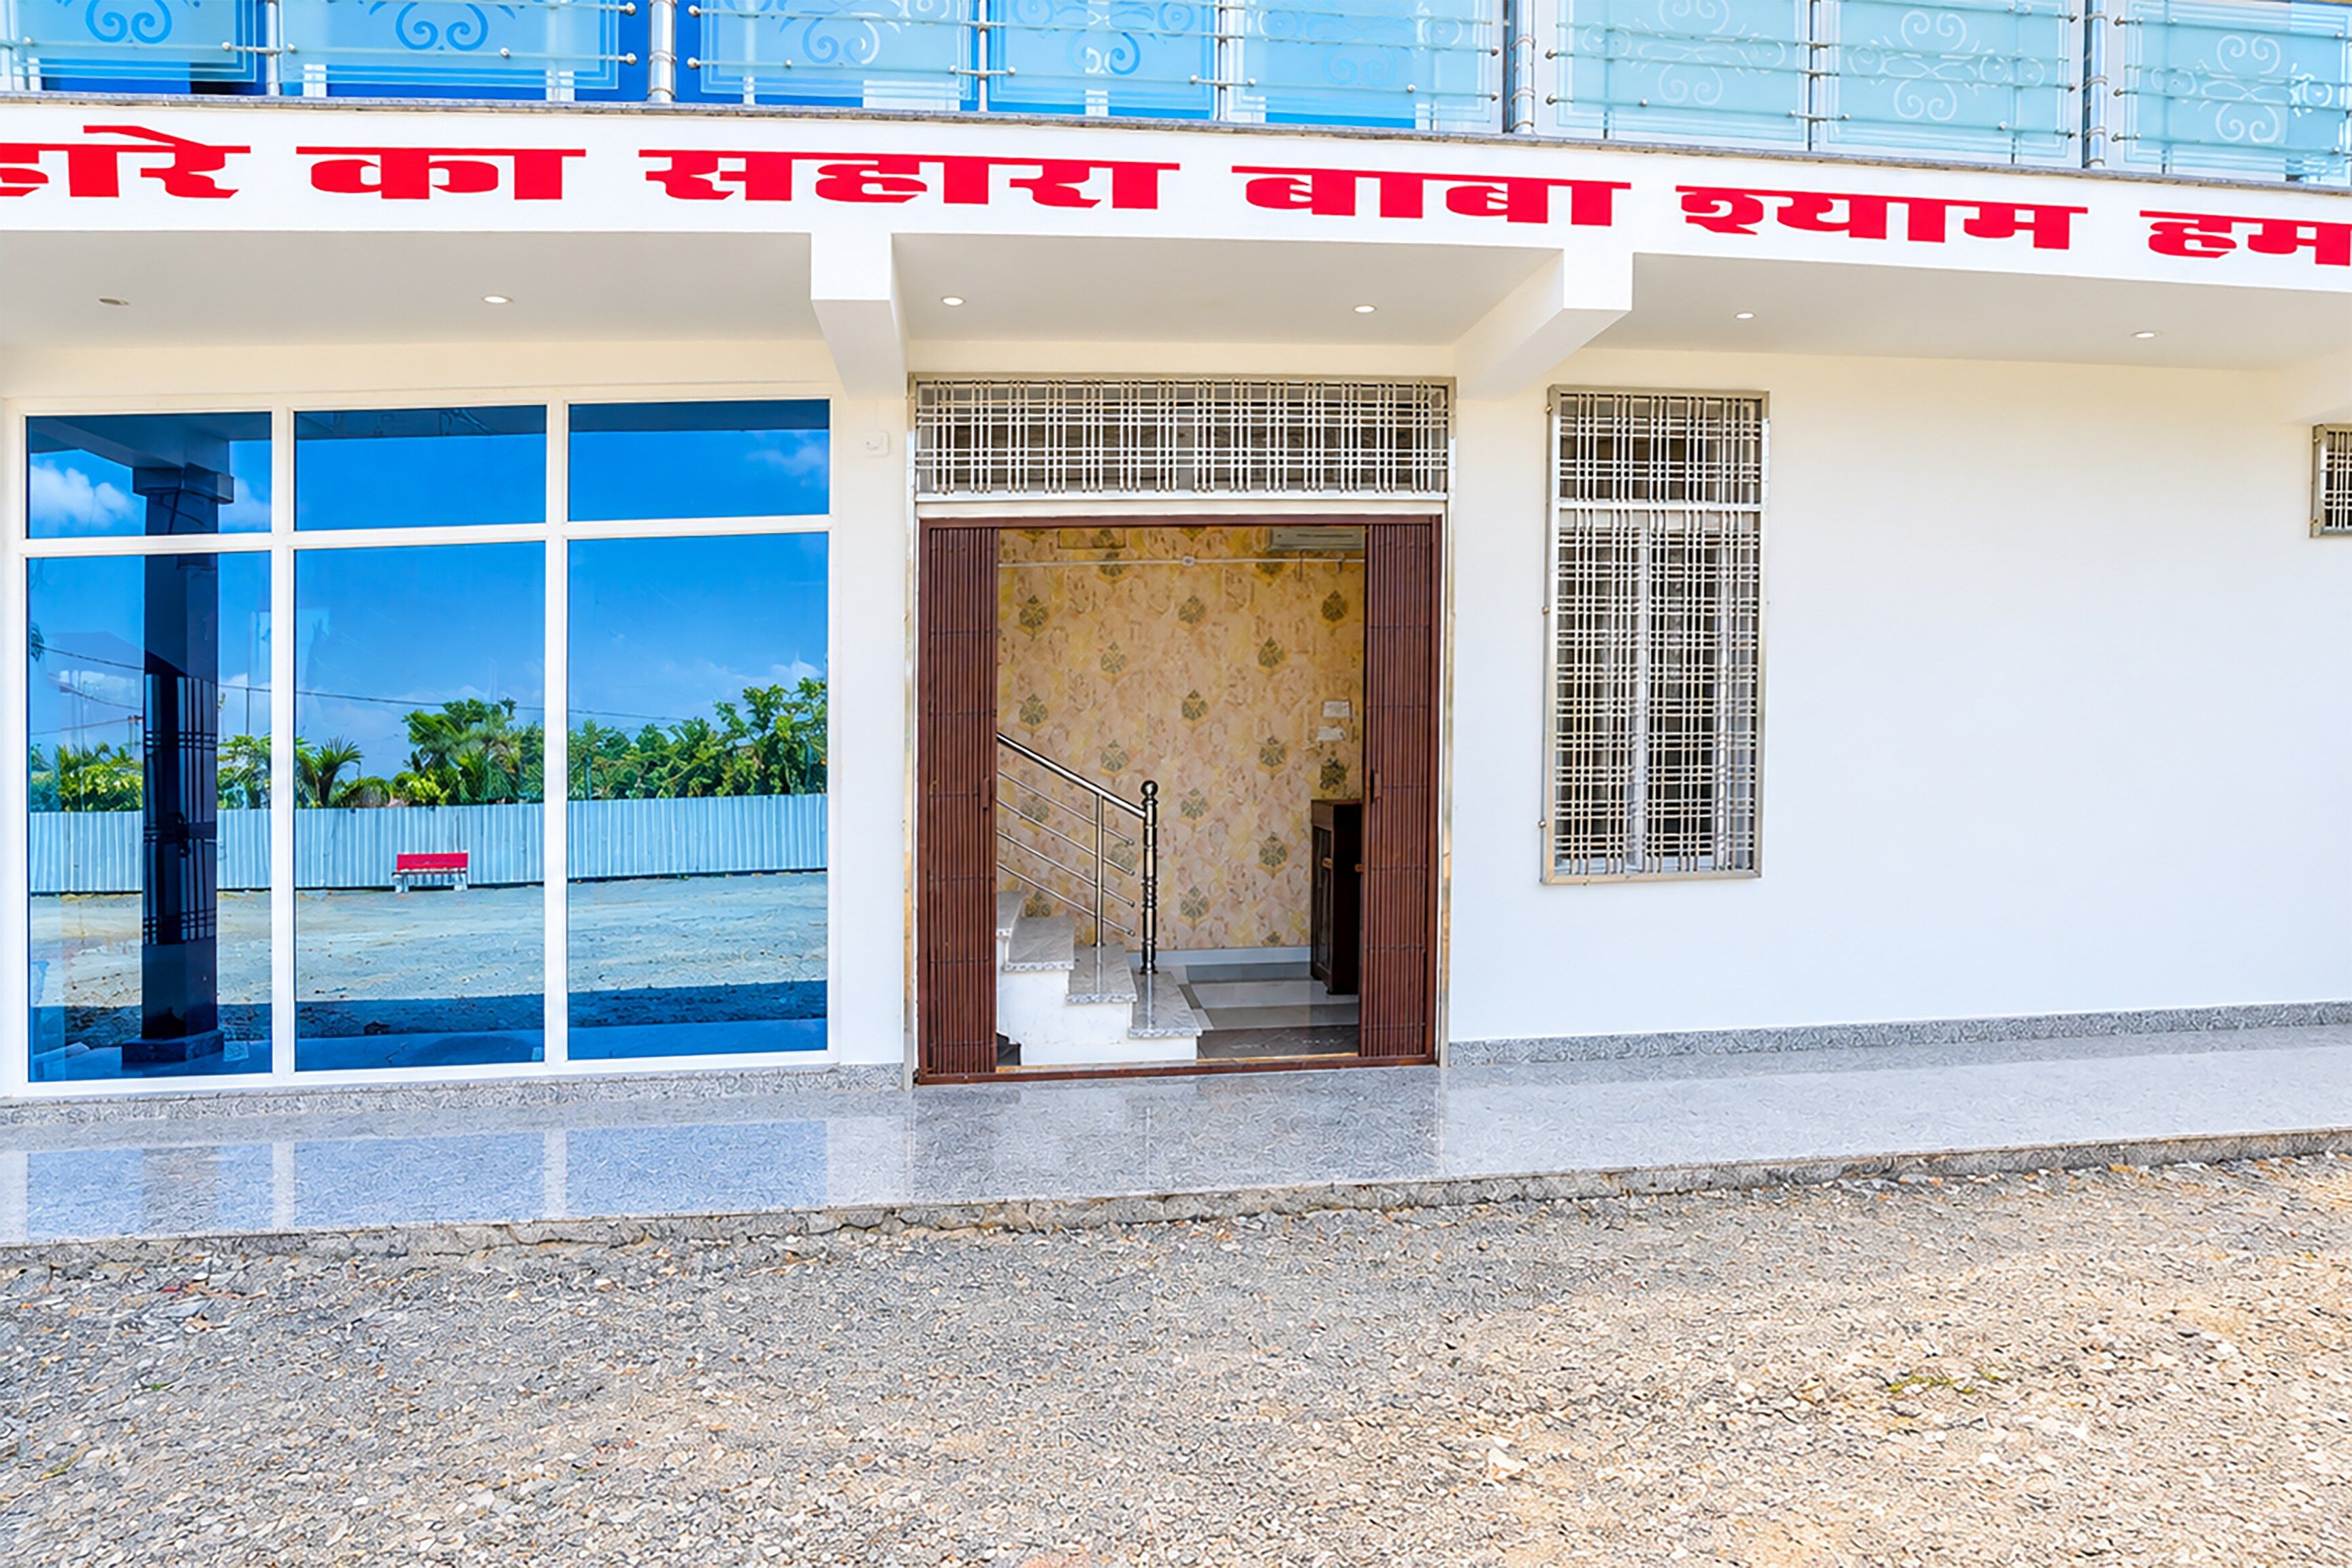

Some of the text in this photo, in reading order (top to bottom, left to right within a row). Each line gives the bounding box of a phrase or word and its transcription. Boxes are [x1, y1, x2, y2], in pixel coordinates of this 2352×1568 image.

[296, 146, 585, 200] का
[638, 149, 1179, 209] सहारा
[1231, 165, 1631, 226] बाबा
[1676, 185, 2088, 250] श्याम
